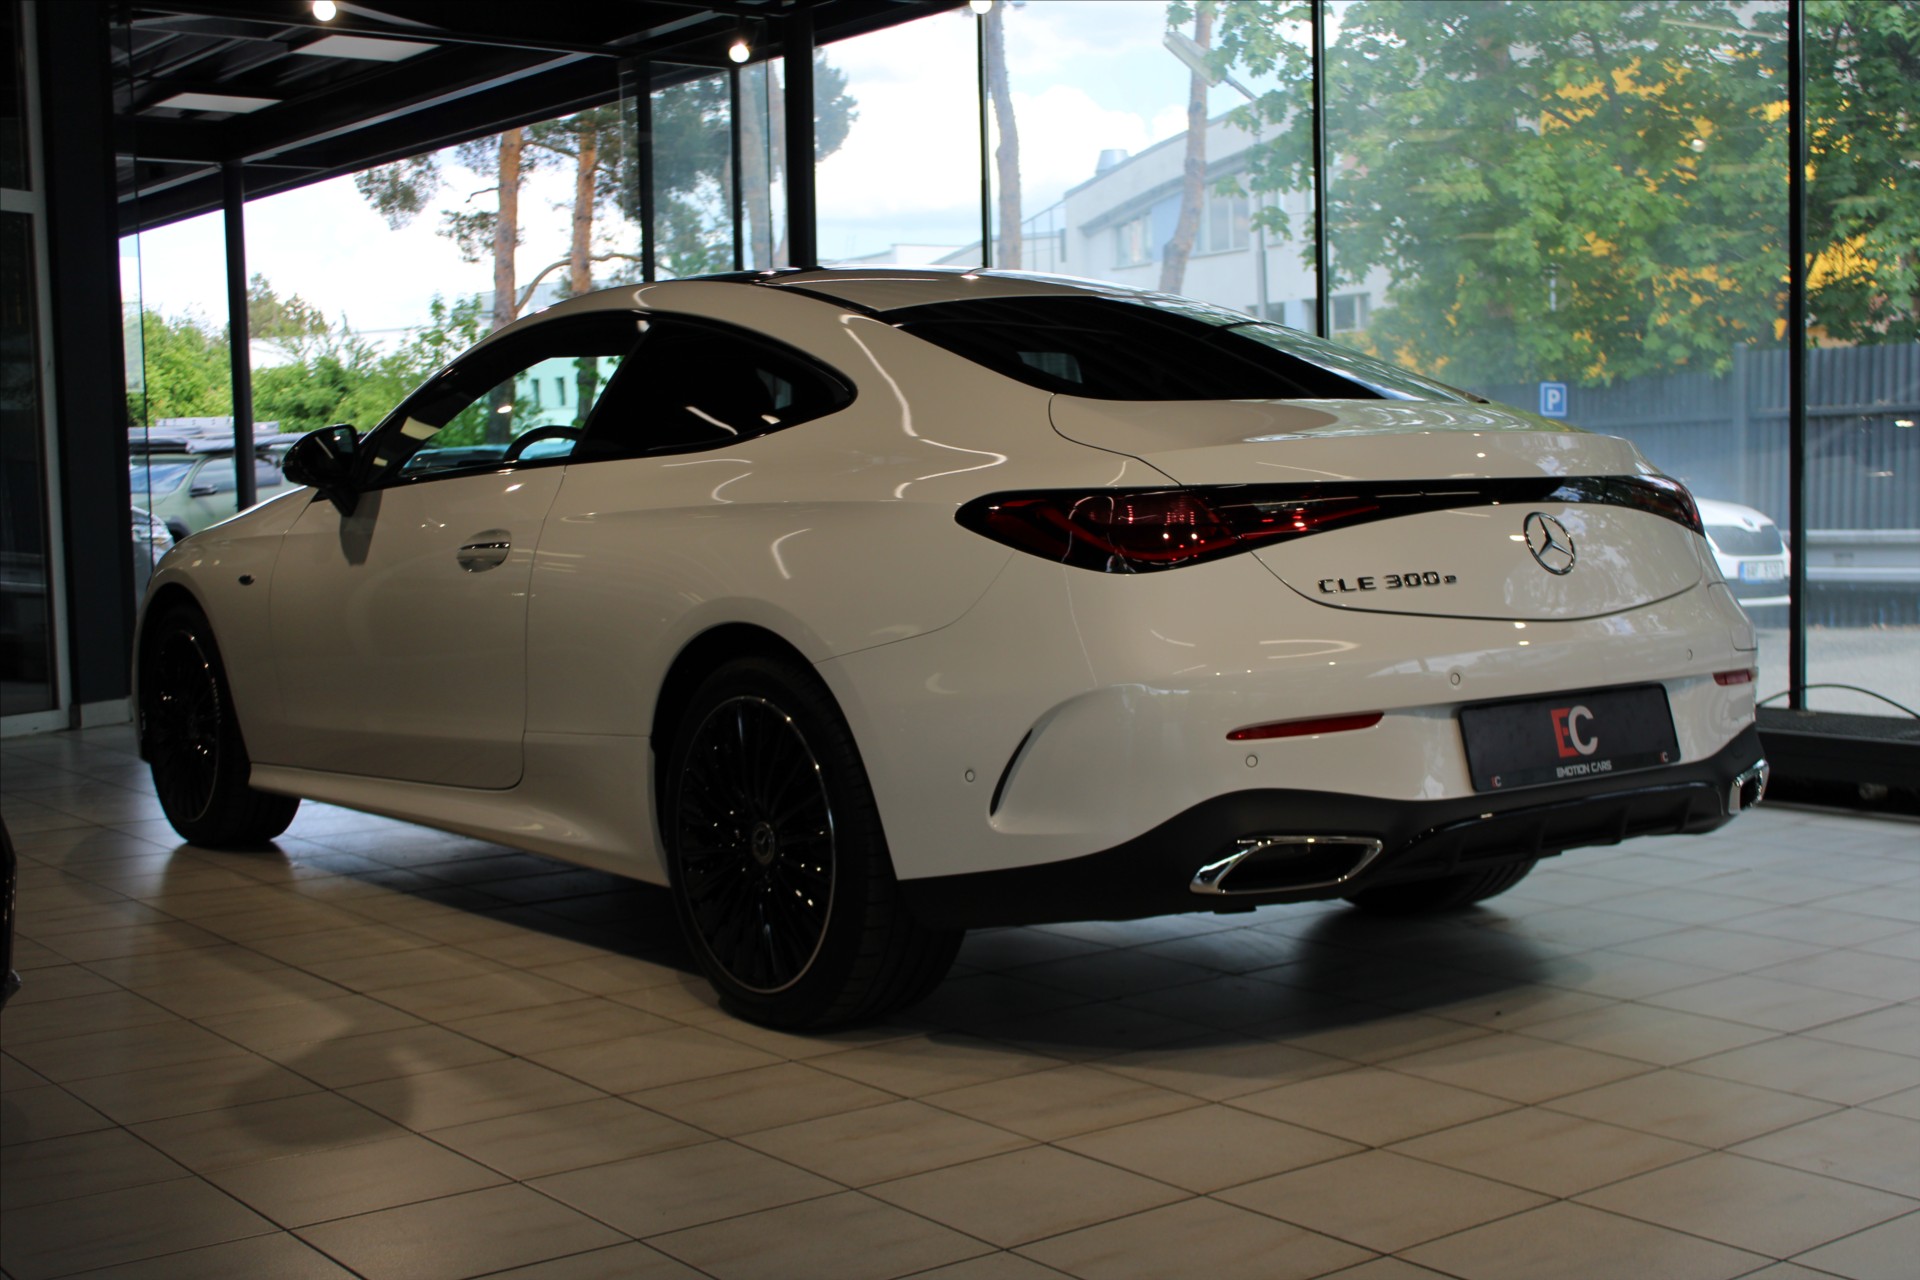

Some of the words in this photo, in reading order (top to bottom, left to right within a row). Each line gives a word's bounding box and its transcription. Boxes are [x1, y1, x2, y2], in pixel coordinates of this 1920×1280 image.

[1548, 389, 1561, 411] P
[1318, 576, 1377, 594] CLE
[1551, 705, 1598, 758] EC
[1556, 763, 1590, 778] EMOTION
[1591, 760, 1612, 773] CARS
